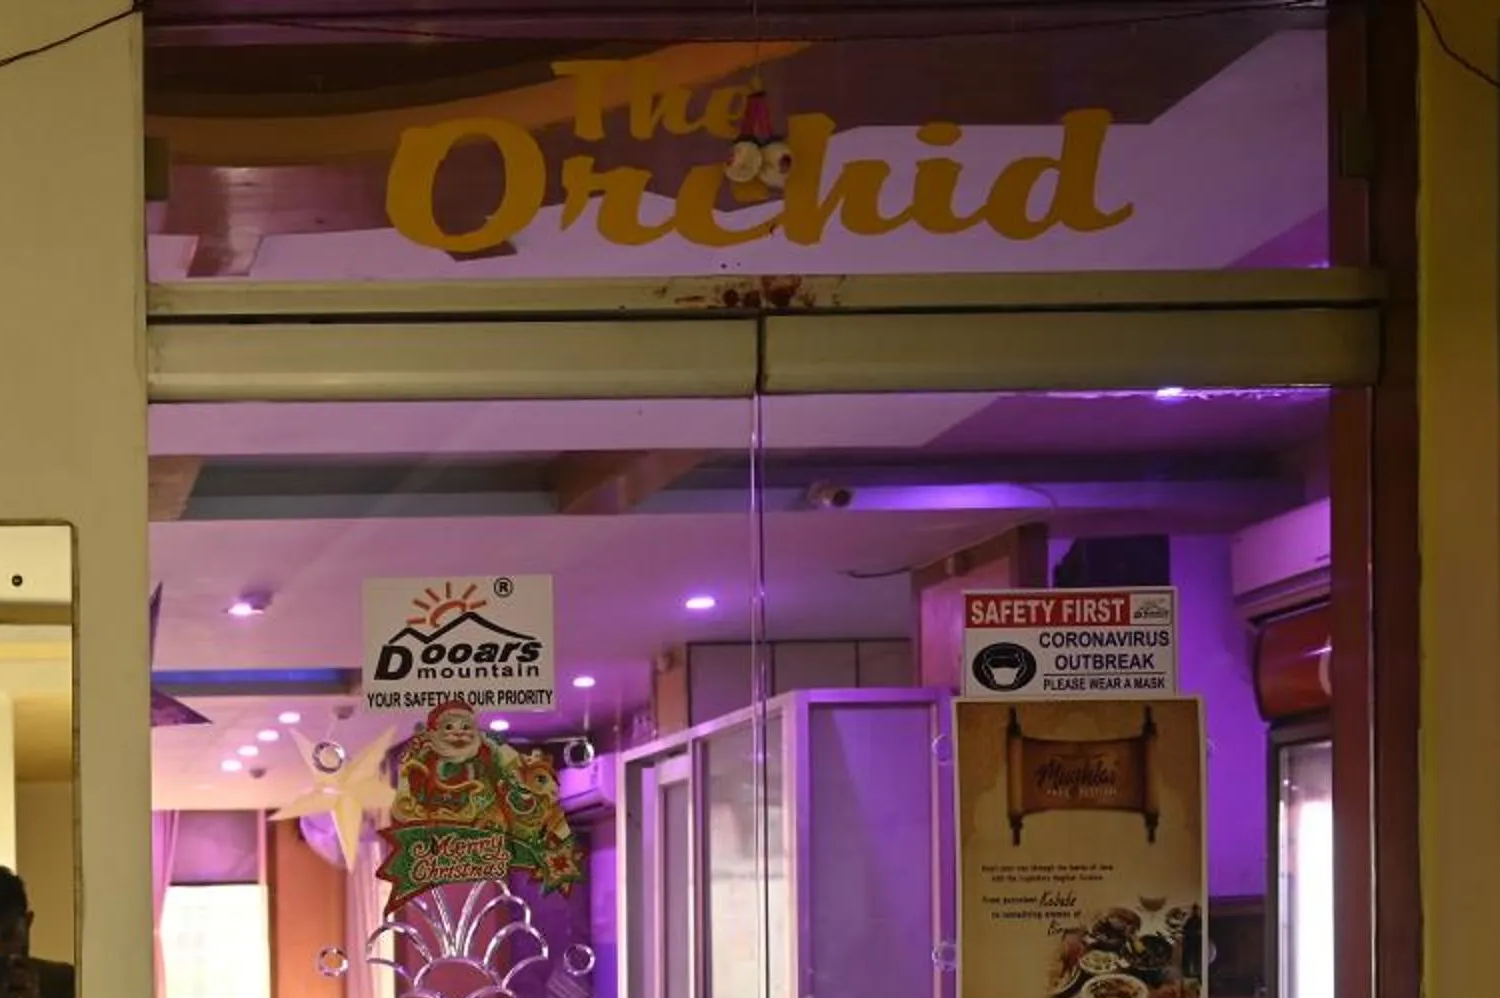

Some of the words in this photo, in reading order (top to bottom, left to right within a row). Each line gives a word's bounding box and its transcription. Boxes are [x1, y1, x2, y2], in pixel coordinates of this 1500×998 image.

[551, 60, 749, 141] The
[386, 108, 1133, 252] Orchid
[971, 599, 1058, 625] SAFETY
[1062, 598, 1125, 623] FIRST
[1039, 630, 1170, 649] CORONAVIRUS
[374, 640, 543, 681] Dooars
[417, 663, 540, 679] mountain
[1055, 653, 1155, 671] OUTBREAK
[1043, 677, 1086, 691] PLEASE
[1089, 677, 1123, 690] WEAR
[1123, 677, 1132, 689] A
[1134, 676, 1165, 689] MASK
[367, 691, 401, 708] YOUR
[403, 691, 451, 708] SAFETY
[467, 690, 496, 706] OUR
[497, 688, 553, 705] PRIORITY
[409, 832, 512, 863] Merry
[408, 857, 510, 884] Christmas
